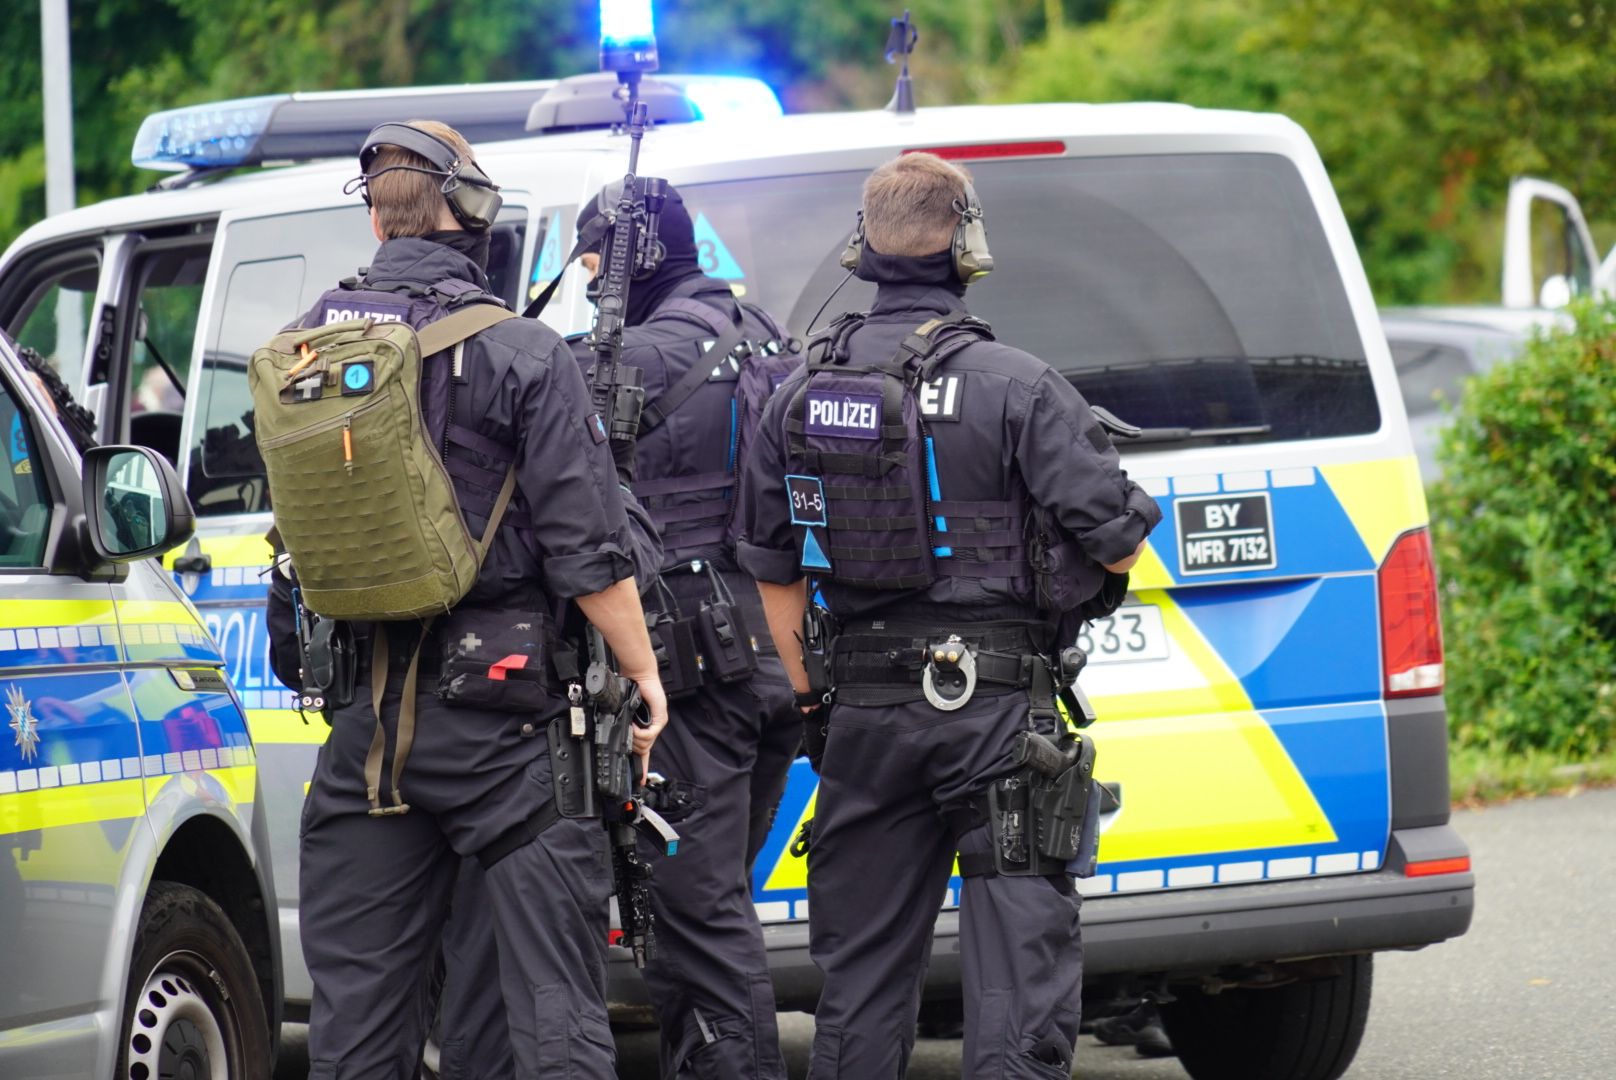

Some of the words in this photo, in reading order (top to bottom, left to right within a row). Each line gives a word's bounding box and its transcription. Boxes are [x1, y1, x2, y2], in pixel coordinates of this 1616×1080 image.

[696, 239, 719, 272] 3
[809, 399, 877, 429] POLIZEI
[792, 490, 823, 511] 31-5
[1204, 503, 1241, 529] BY
[1186, 539, 1226, 565] MFR
[1228, 536, 1268, 562] 7132
[205, 612, 285, 687] POLI
